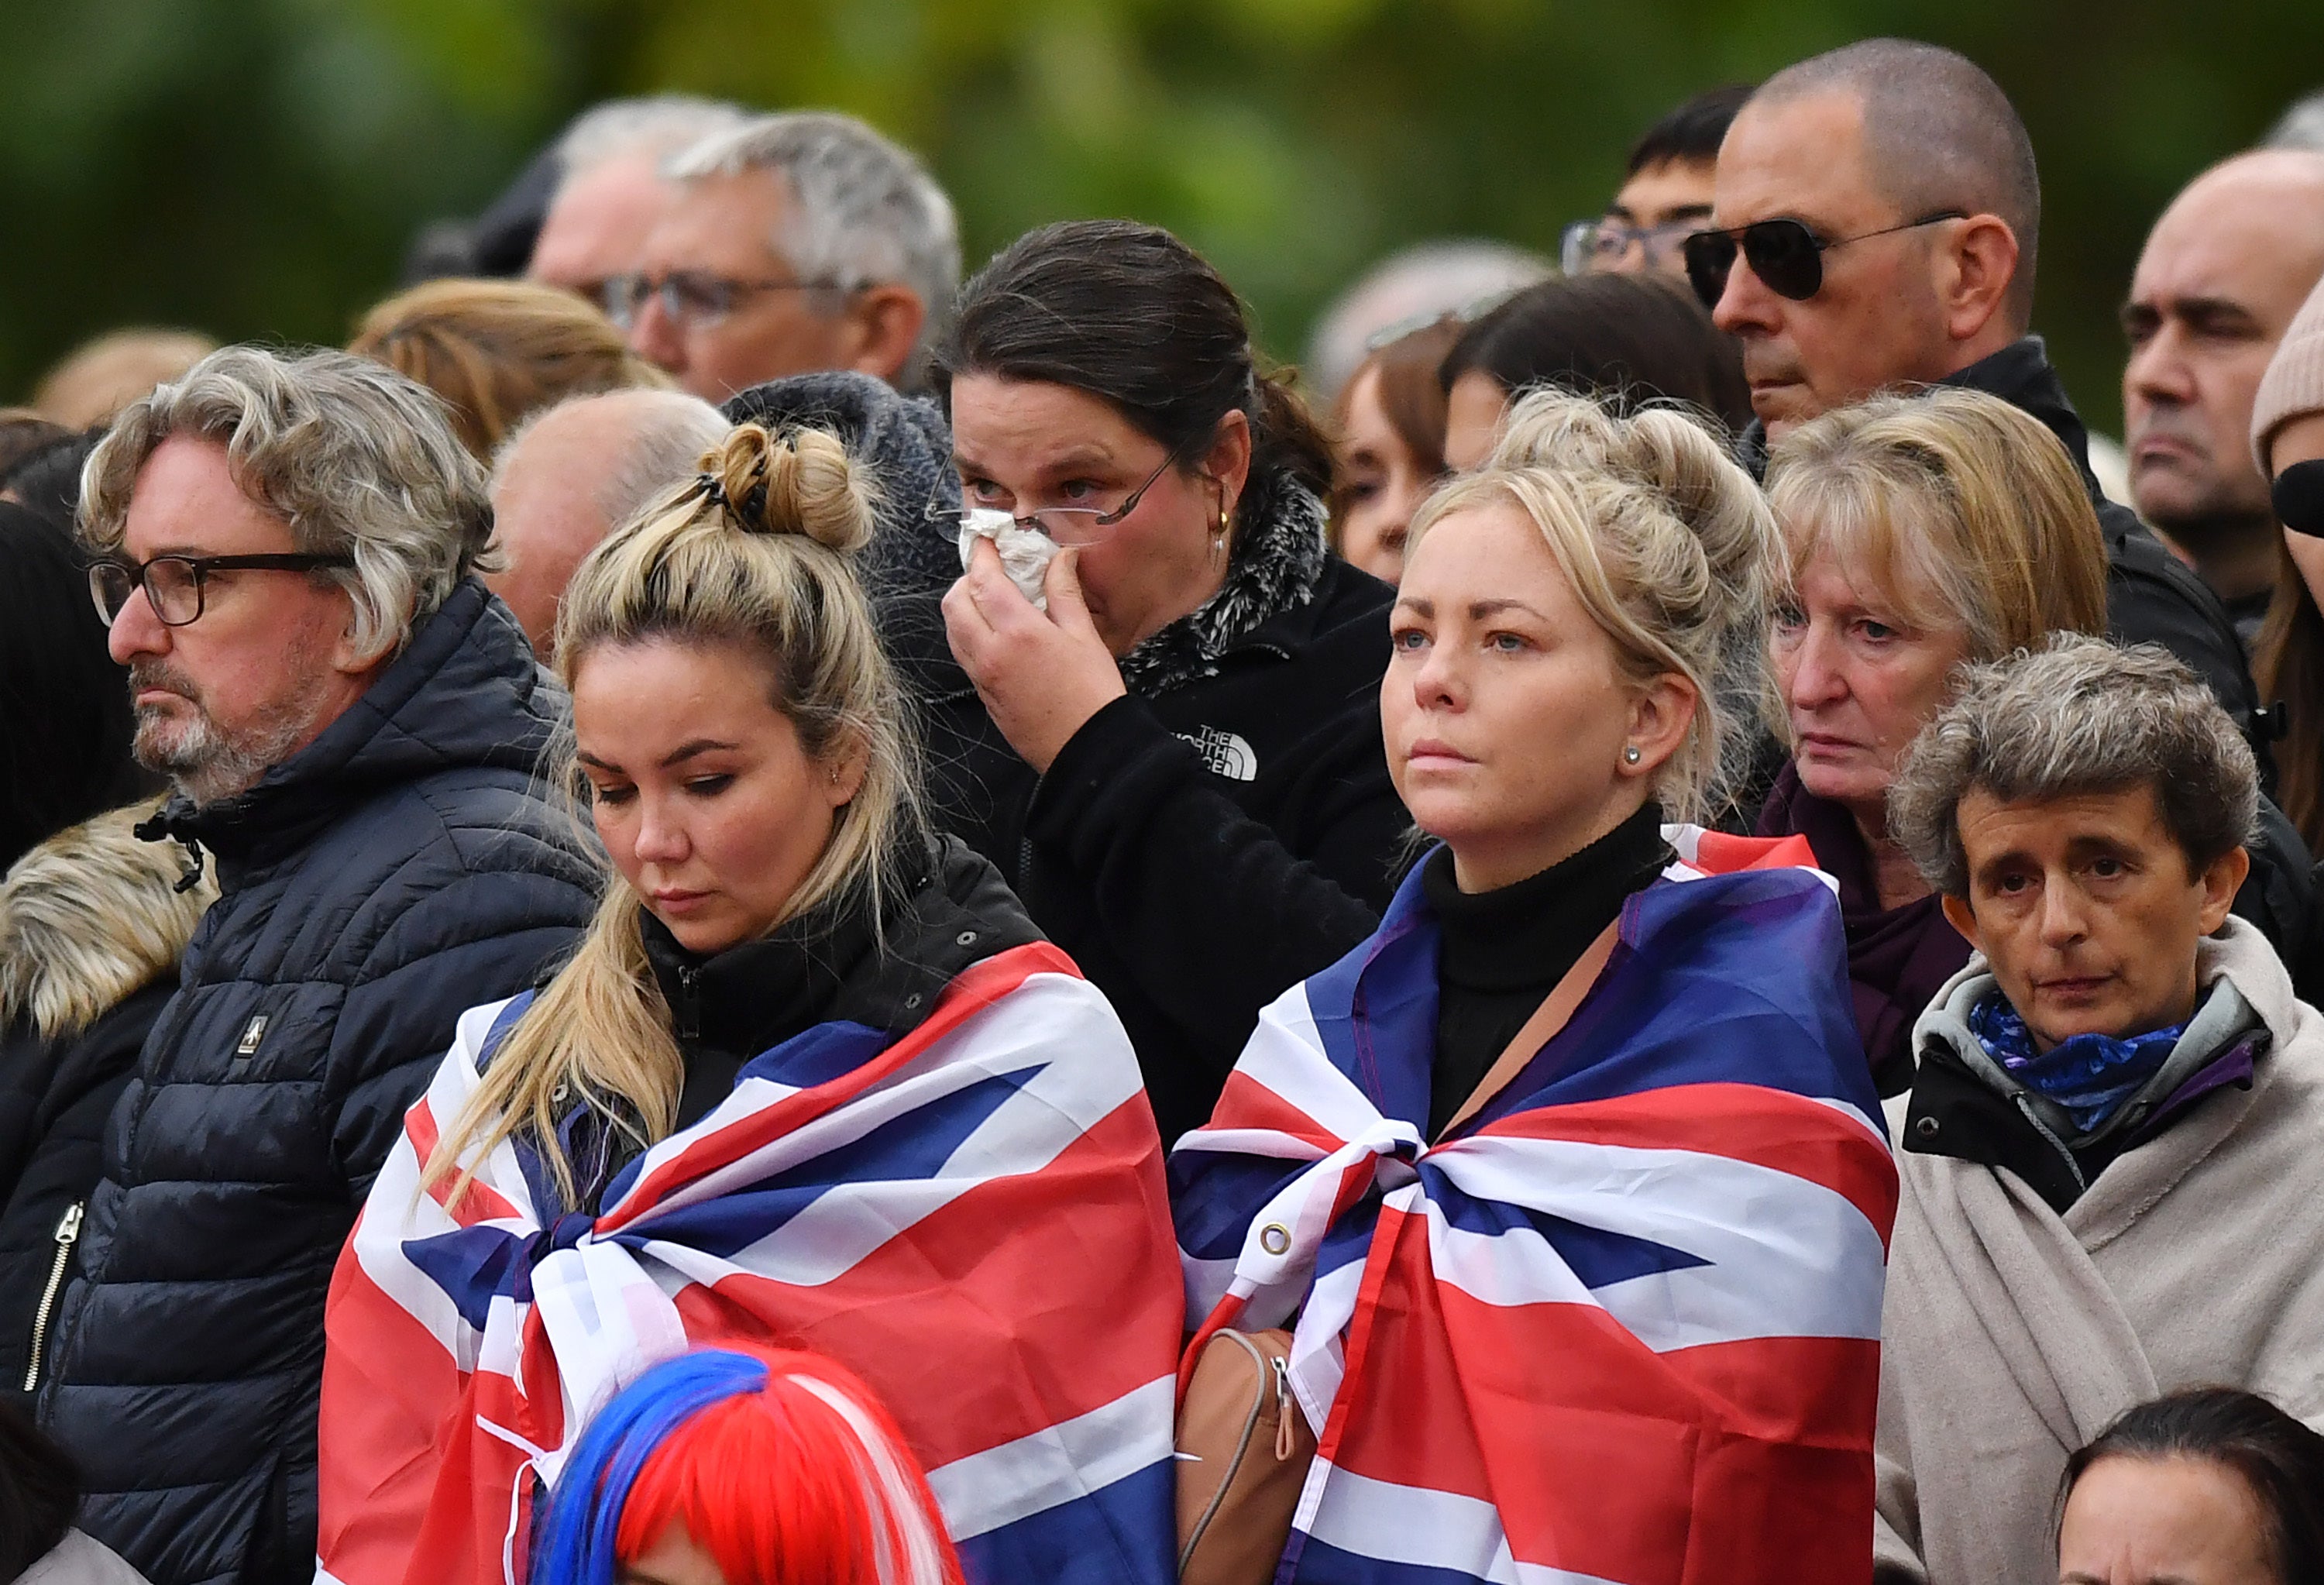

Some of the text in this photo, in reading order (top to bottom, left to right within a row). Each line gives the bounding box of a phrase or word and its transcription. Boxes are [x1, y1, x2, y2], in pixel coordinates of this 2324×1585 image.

[1201, 724, 1231, 745] THE
[1171, 733, 1228, 760] ORTH
[1202, 756, 1224, 773] CE
